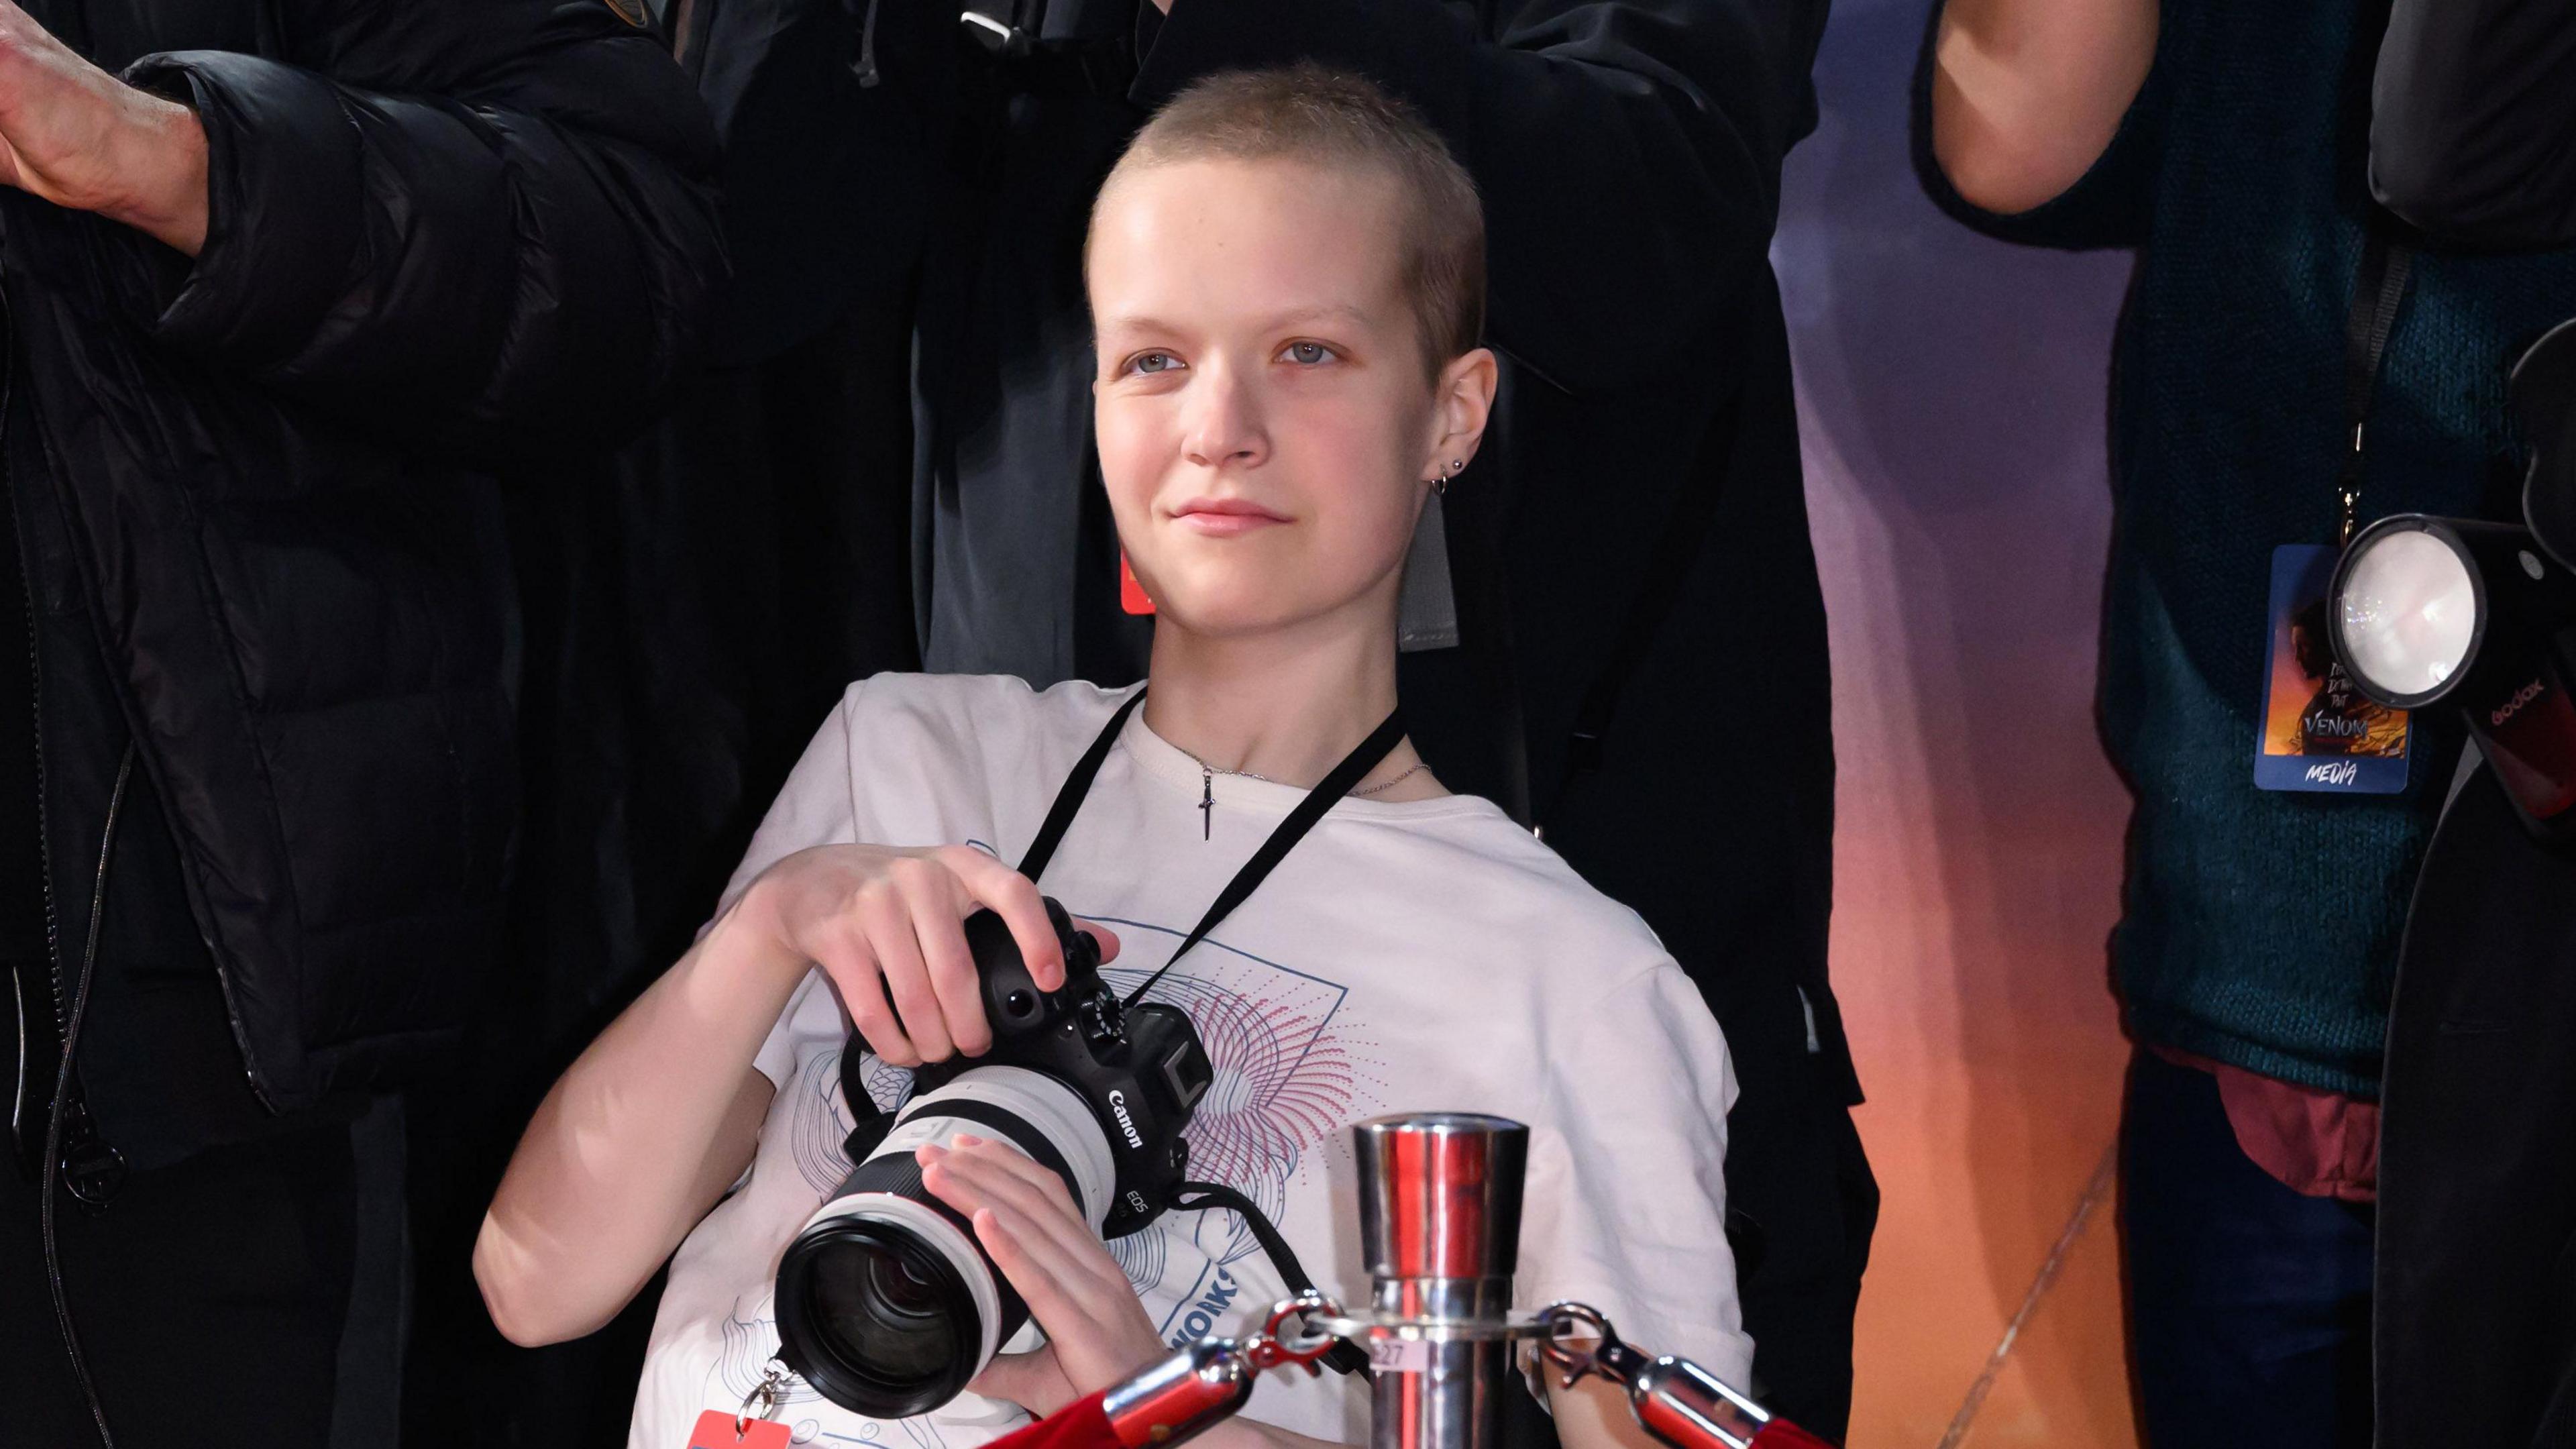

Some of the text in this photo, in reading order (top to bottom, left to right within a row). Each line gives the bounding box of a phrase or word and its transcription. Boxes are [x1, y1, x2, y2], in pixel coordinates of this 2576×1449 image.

[2304, 710, 2368, 739] VENOM
[2305, 760, 2357, 786] MEDIA
[1109, 1089, 1143, 1149] Canon
[1126, 1190, 1149, 1213] EOS
